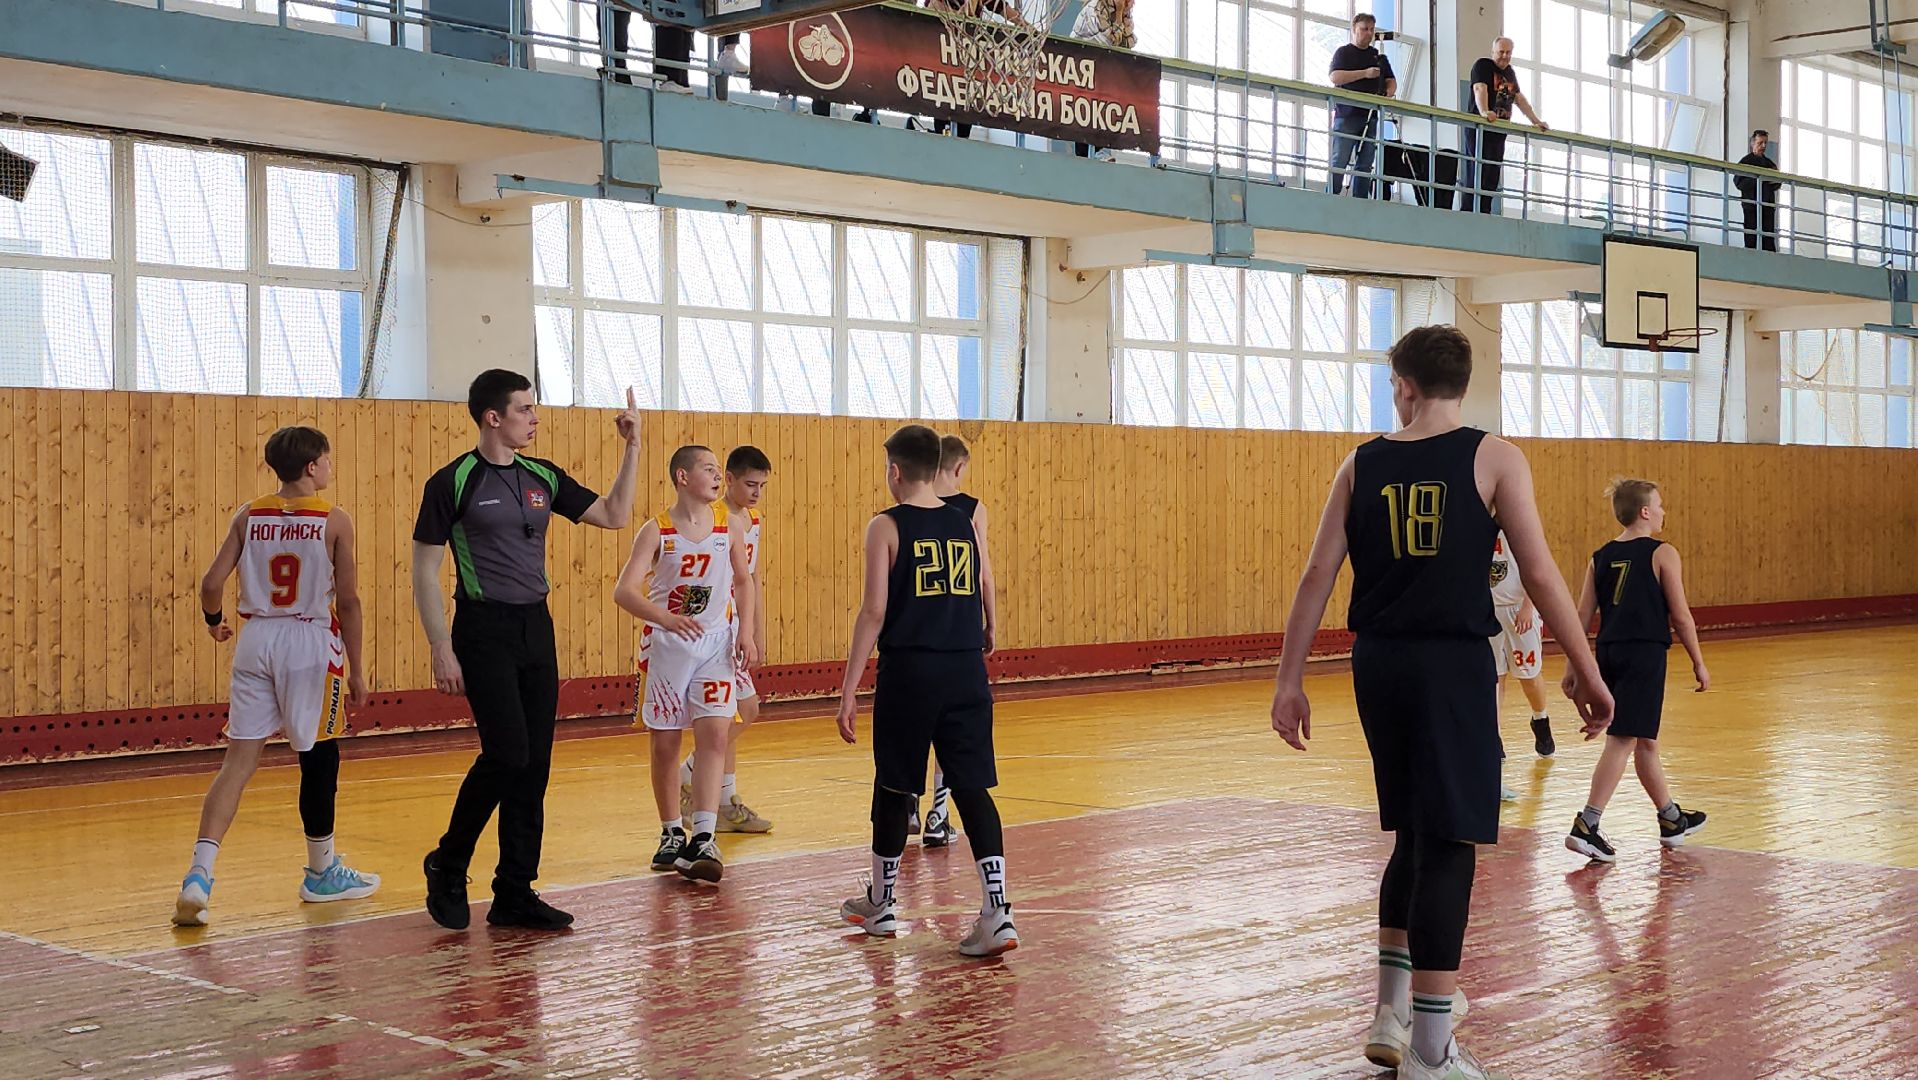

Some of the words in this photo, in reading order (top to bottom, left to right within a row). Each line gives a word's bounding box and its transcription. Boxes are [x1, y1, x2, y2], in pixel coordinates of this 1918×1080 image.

[897, 65, 1053, 122] ФЕДЕРАЦИЯ
[1060, 94, 1141, 135] БОКСА
[250, 523, 323, 541] НОГИНСК
[1381, 481, 1448, 560] 18
[269, 552, 301, 608] 9
[680, 553, 711, 578] 27
[913, 538, 976, 597] 20
[1611, 560, 1632, 606] 7
[1512, 649, 1536, 667] 34
[703, 681, 732, 705] 27
